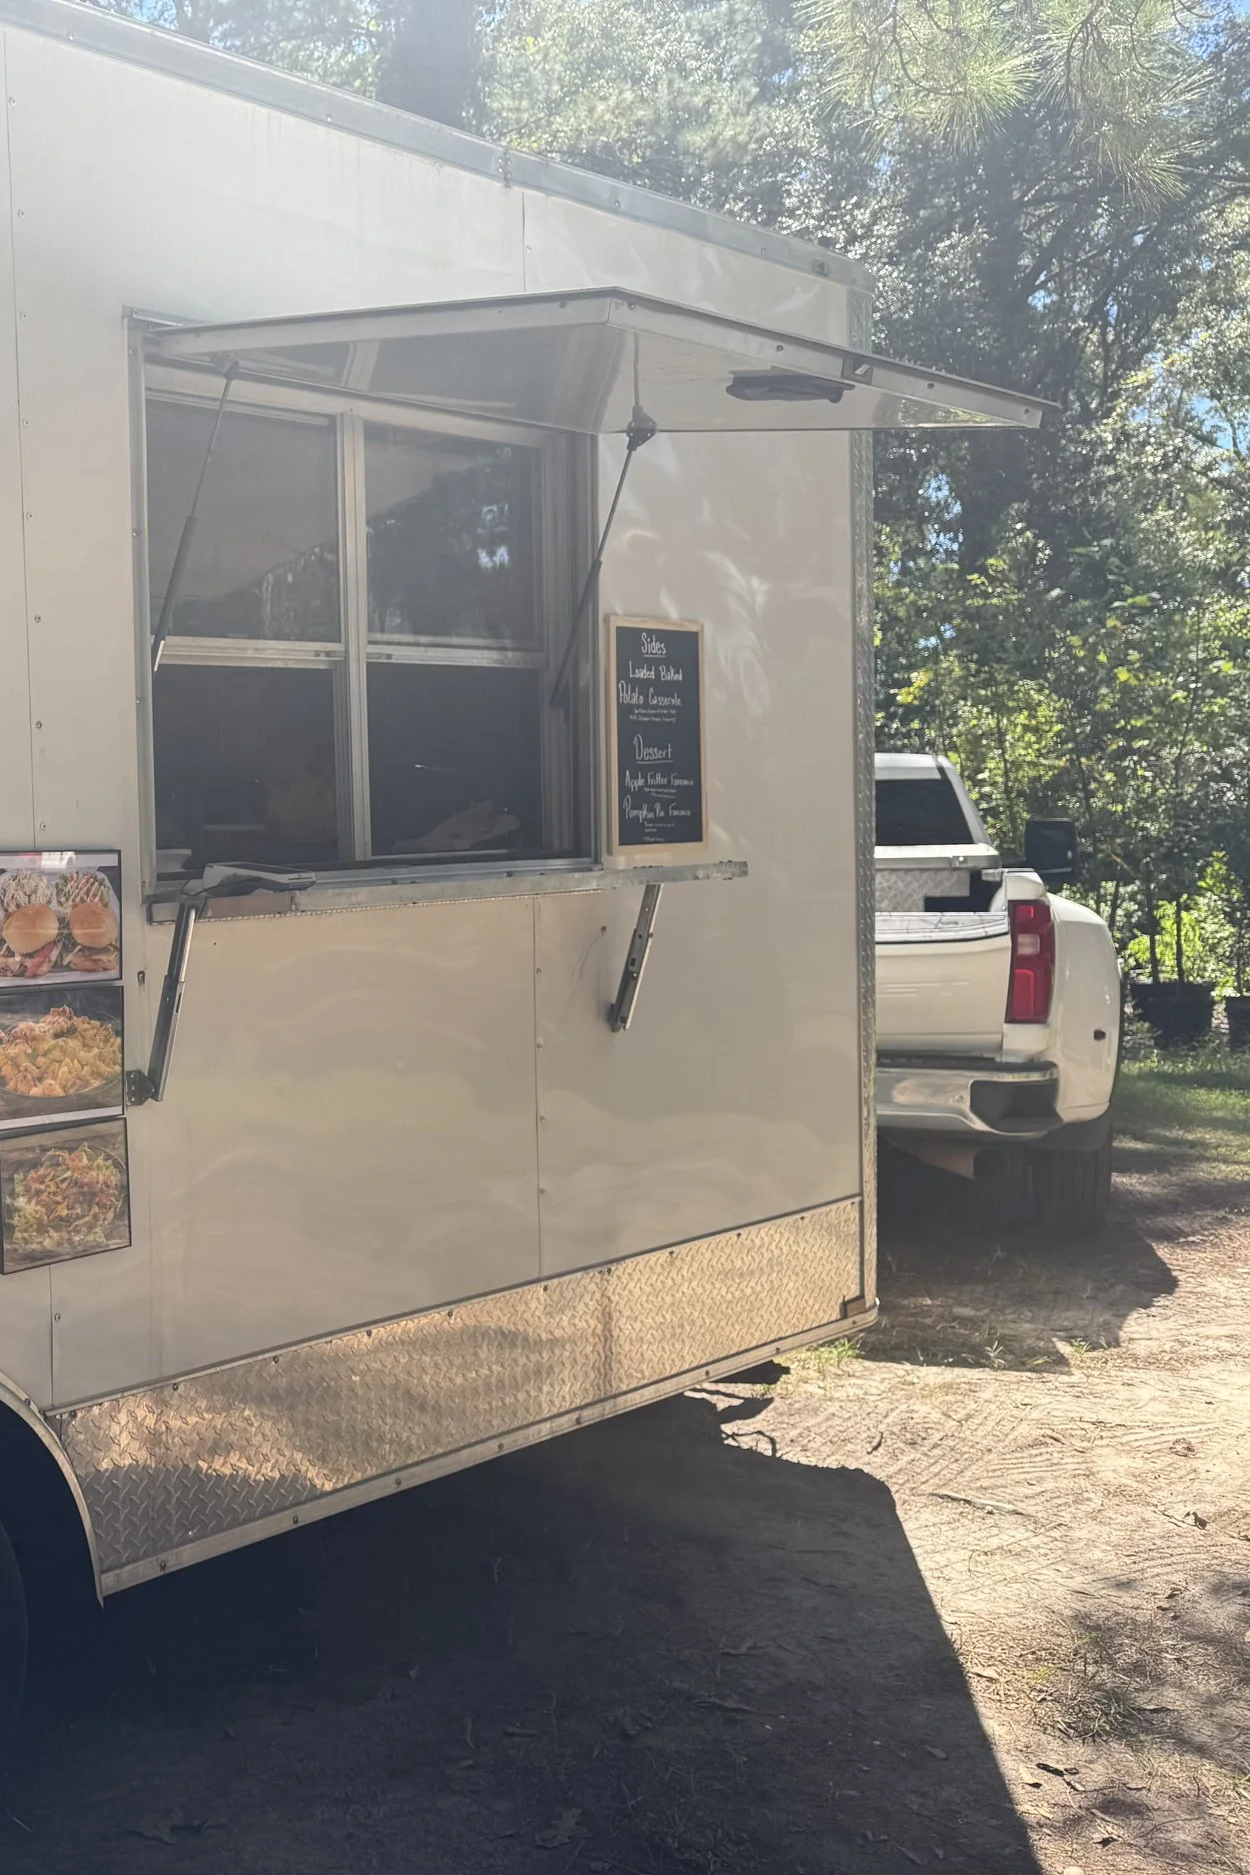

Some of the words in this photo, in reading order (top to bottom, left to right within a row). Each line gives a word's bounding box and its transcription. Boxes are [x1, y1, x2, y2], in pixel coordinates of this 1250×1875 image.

[641, 632, 666, 654] Sides
[629, 660, 655, 679] Loaded
[659, 664, 683, 681] Baked
[618, 680, 644, 704] Potato
[648, 686, 682, 706] Casserole
[633, 734, 672, 760] Dessert
[625, 769, 645, 792] Apple
[647, 771, 668, 786] Fritter
[623, 795, 654, 824] Pumpkin
[654, 801, 665, 818] Pie
